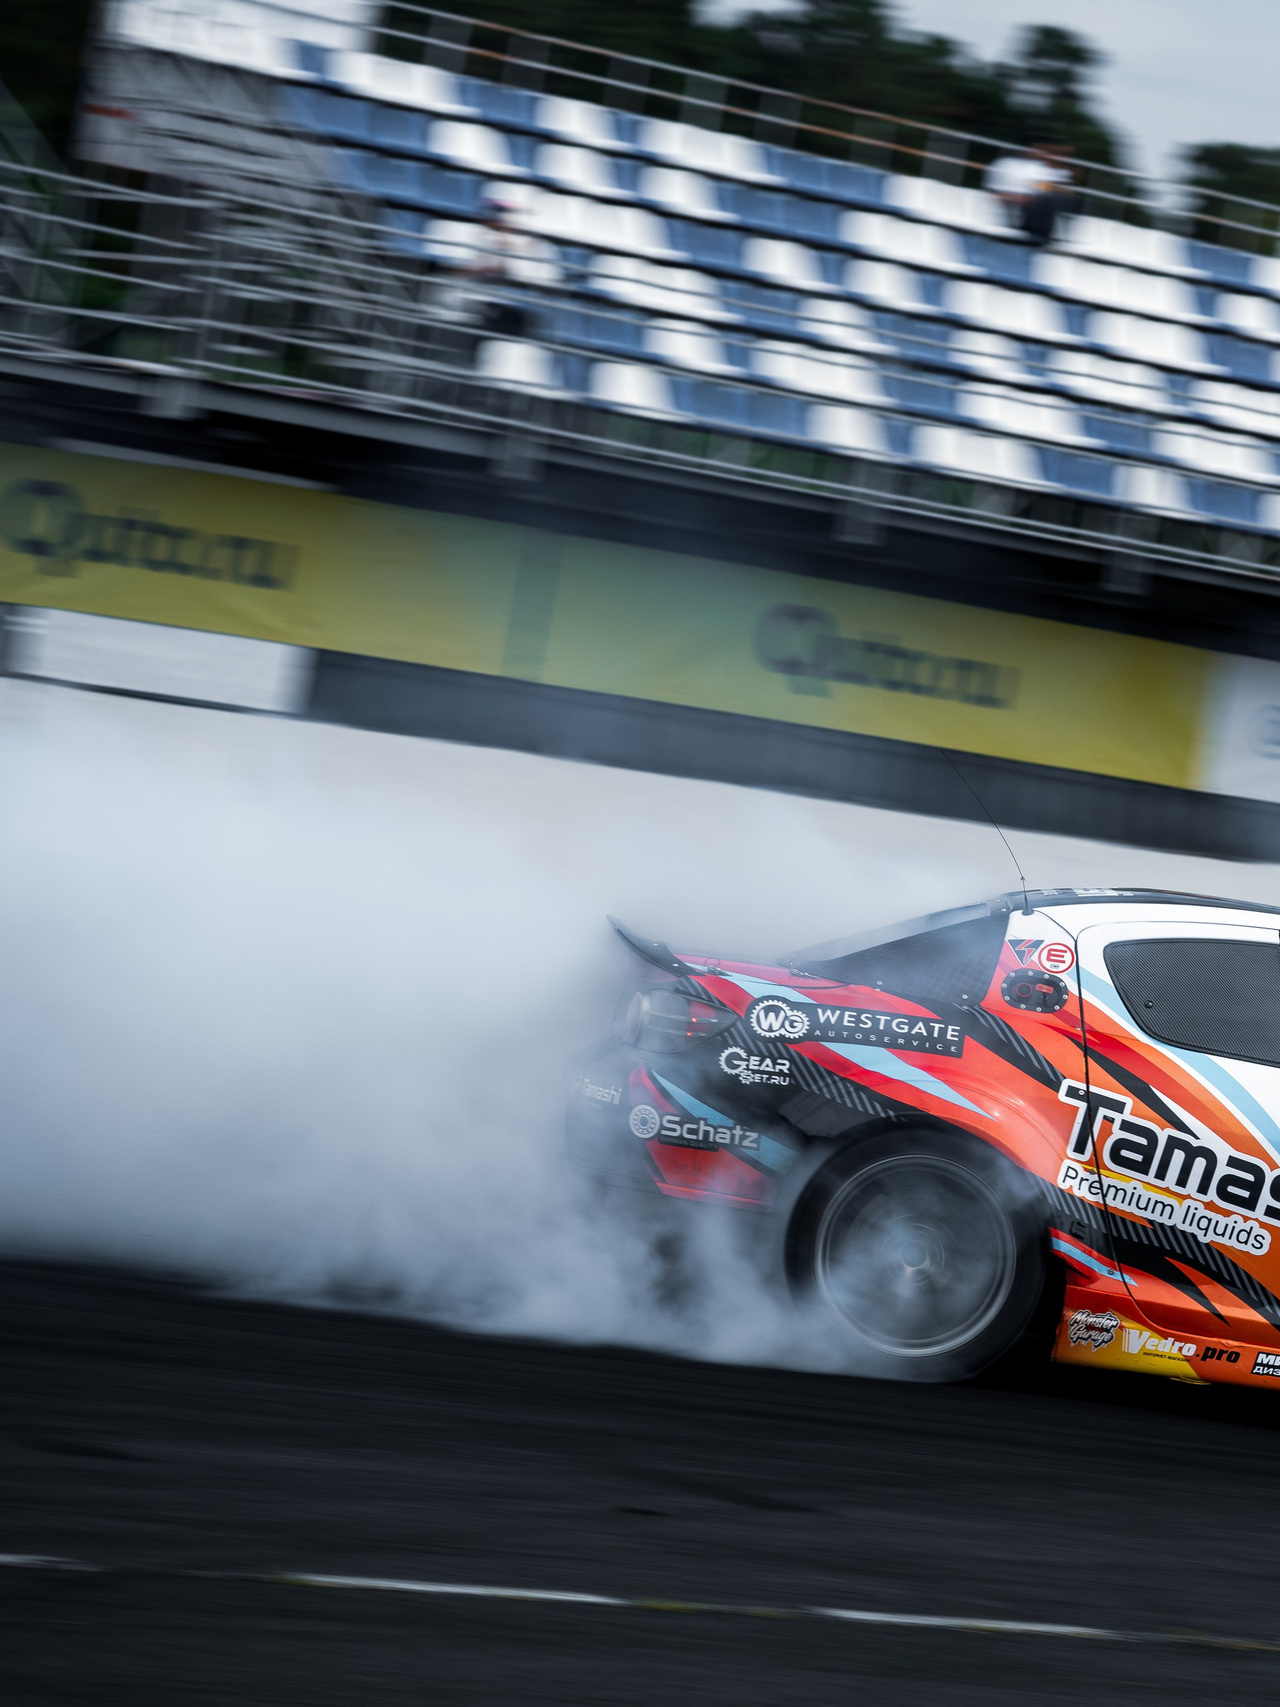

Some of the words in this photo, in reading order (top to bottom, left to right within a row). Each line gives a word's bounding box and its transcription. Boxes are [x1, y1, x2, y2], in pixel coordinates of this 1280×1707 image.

[817, 1008, 961, 1041] WESTGATE
[814, 1030, 957, 1052] AUTOSERVICE
[718, 1046, 790, 1075] GEAR
[660, 1115, 759, 1148] Schatz
[1062, 1165, 1174, 1220] Premium
[1181, 1204, 1266, 1250] liquids
[1070, 1311, 1117, 1330] Monster
[1070, 1325, 1112, 1346] Garage
